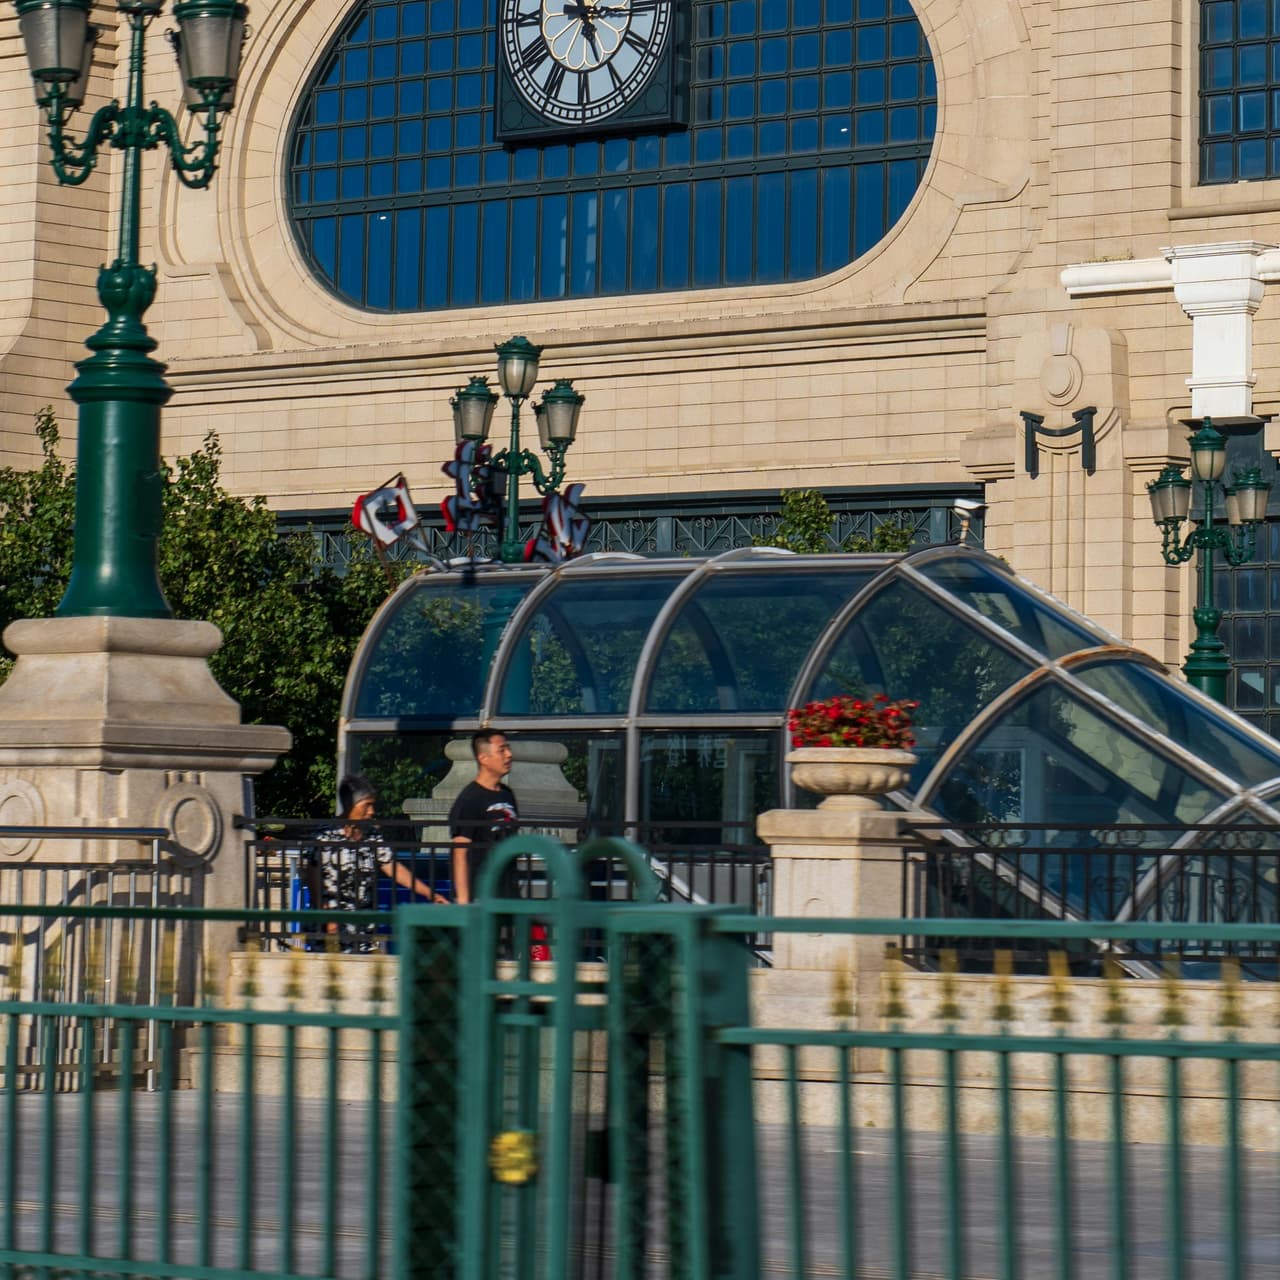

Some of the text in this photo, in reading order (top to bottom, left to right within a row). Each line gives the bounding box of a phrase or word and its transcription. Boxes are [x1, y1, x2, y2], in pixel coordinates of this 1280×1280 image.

[517, 9, 540, 27] IX
[543, 63, 565, 100] VII
[577, 71, 590, 104] VI
[606, 60, 623, 89] V
